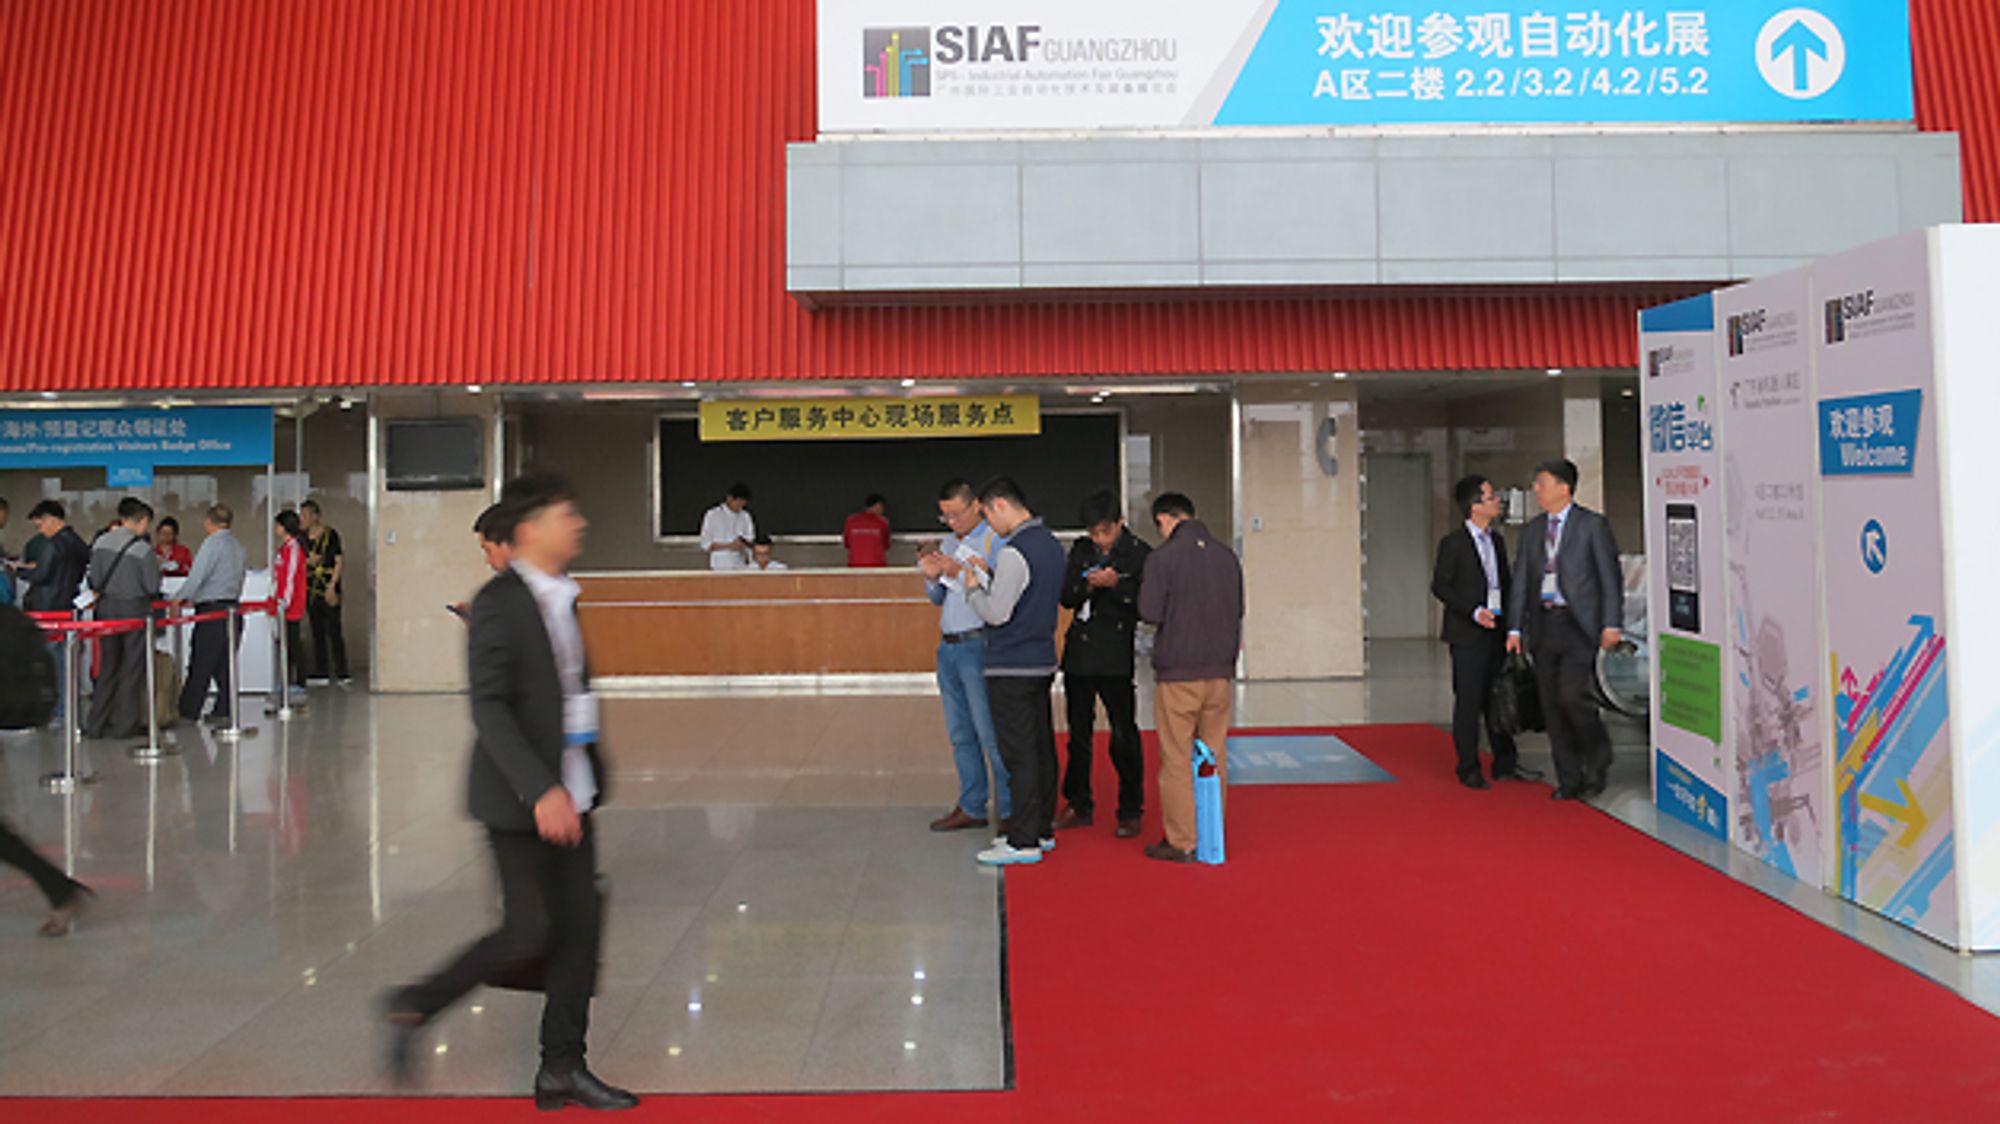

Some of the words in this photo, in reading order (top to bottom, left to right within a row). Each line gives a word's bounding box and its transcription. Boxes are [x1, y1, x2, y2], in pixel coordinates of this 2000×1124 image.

[935, 25, 1041, 64] SIAF
[1043, 38, 1177, 63] GUANGZHOU
[1316, 12, 1711, 57] 欢迎参观自动化展
[1025, 69, 1087, 80] Automation
[1115, 67, 1178, 81] Guangzhou
[1313, 69, 1445, 100] A区二楼
[1843, 289, 1874, 320] SIAF
[726, 402, 1016, 431] 客户服务中心现场服务点
[1829, 404, 1895, 439] 欢迎参观
[198, 439, 232, 451] Office
[1839, 442, 1909, 467] Welcome
